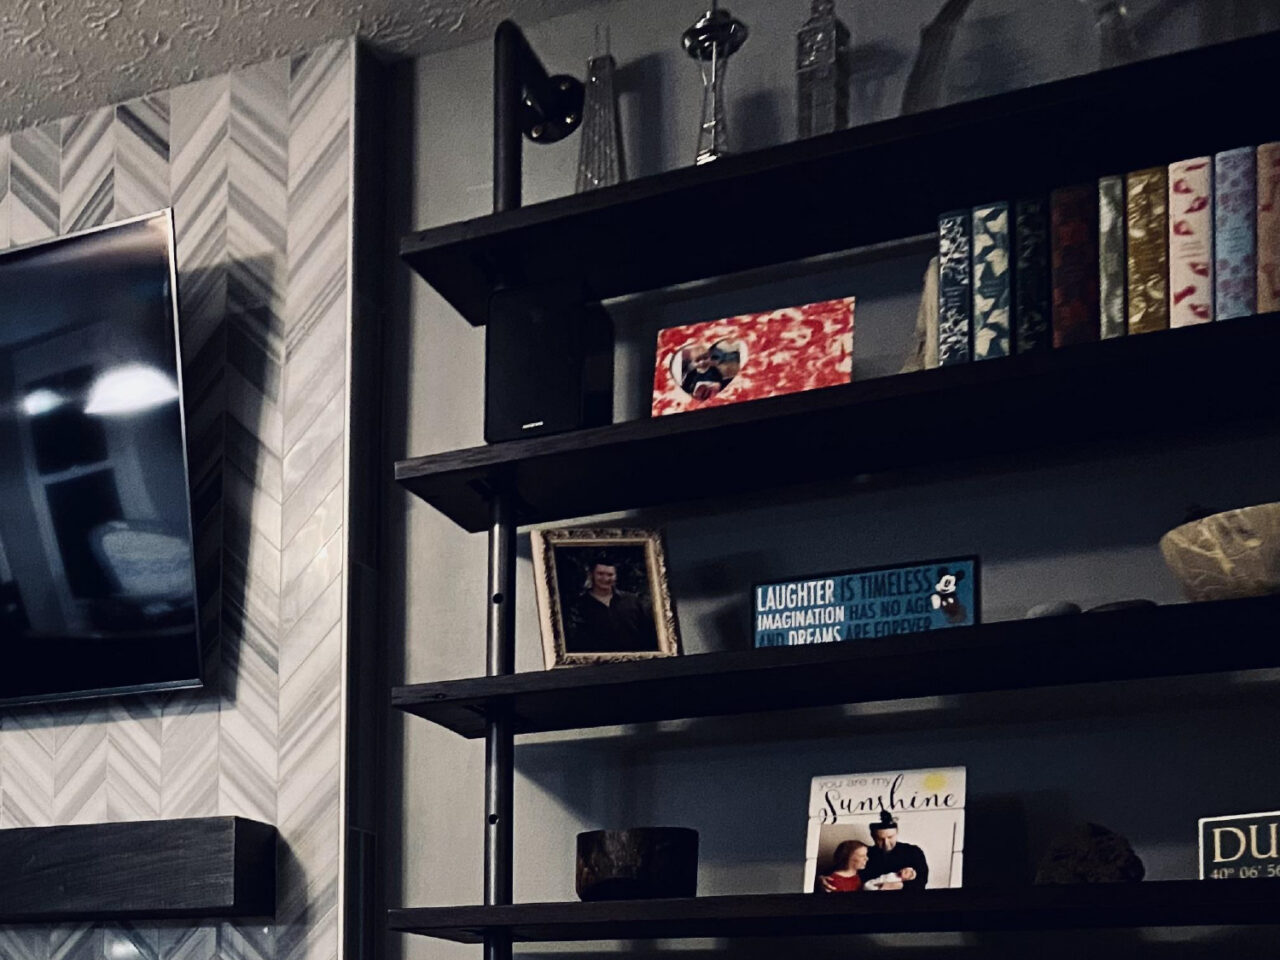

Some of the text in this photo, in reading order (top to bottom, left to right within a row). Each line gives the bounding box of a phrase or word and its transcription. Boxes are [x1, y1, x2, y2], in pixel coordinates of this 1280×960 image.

[757, 568, 932, 612] LAUGHTER IS TIMELESS
[757, 596, 932, 632] IMAGINATION HAS NO AGE
[758, 617, 932, 648] AND DREAMS ARE FOREVER
[818, 773, 959, 825] Sunshine
[819, 776, 892, 790] you are my
